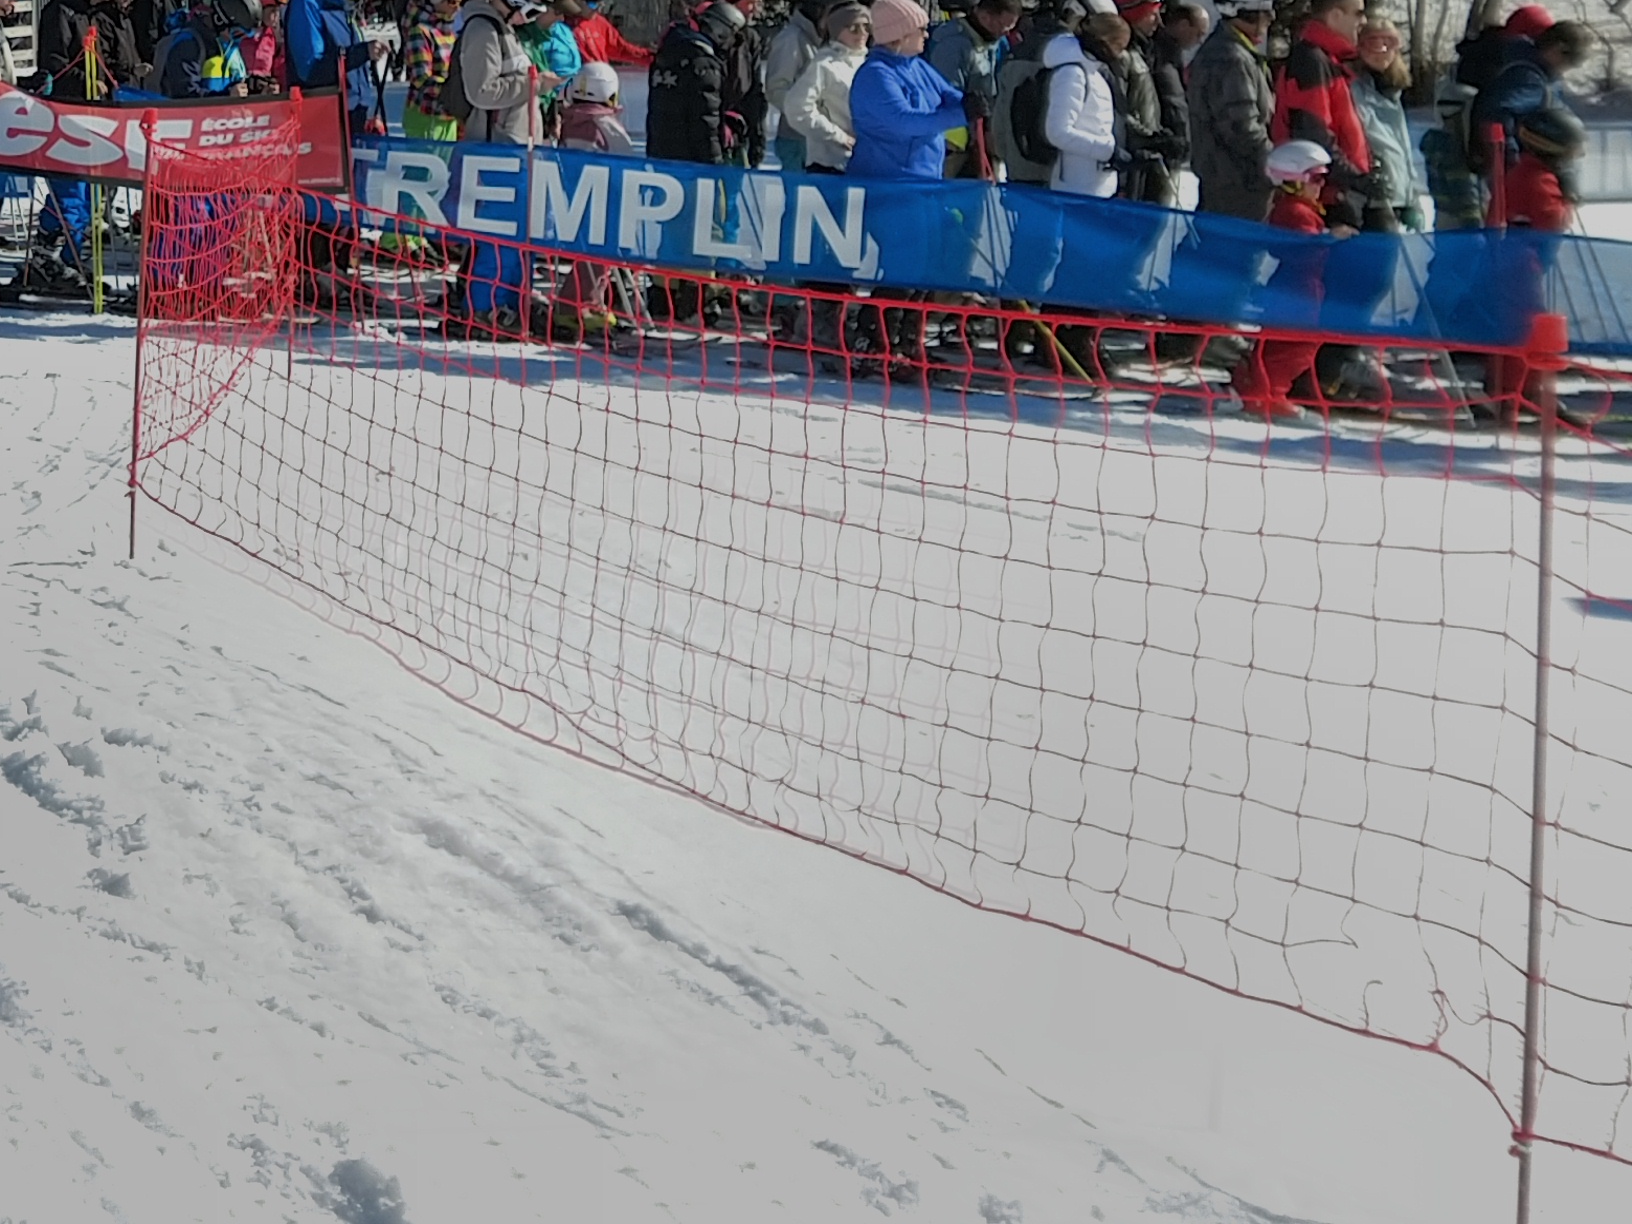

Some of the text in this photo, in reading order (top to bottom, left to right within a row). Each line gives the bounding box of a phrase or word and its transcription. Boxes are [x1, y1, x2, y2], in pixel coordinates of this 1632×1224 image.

[200, 115, 270, 132] ÉCOLE
[198, 132, 235, 147] DU
[198, 142, 312, 162] ANÇAS
